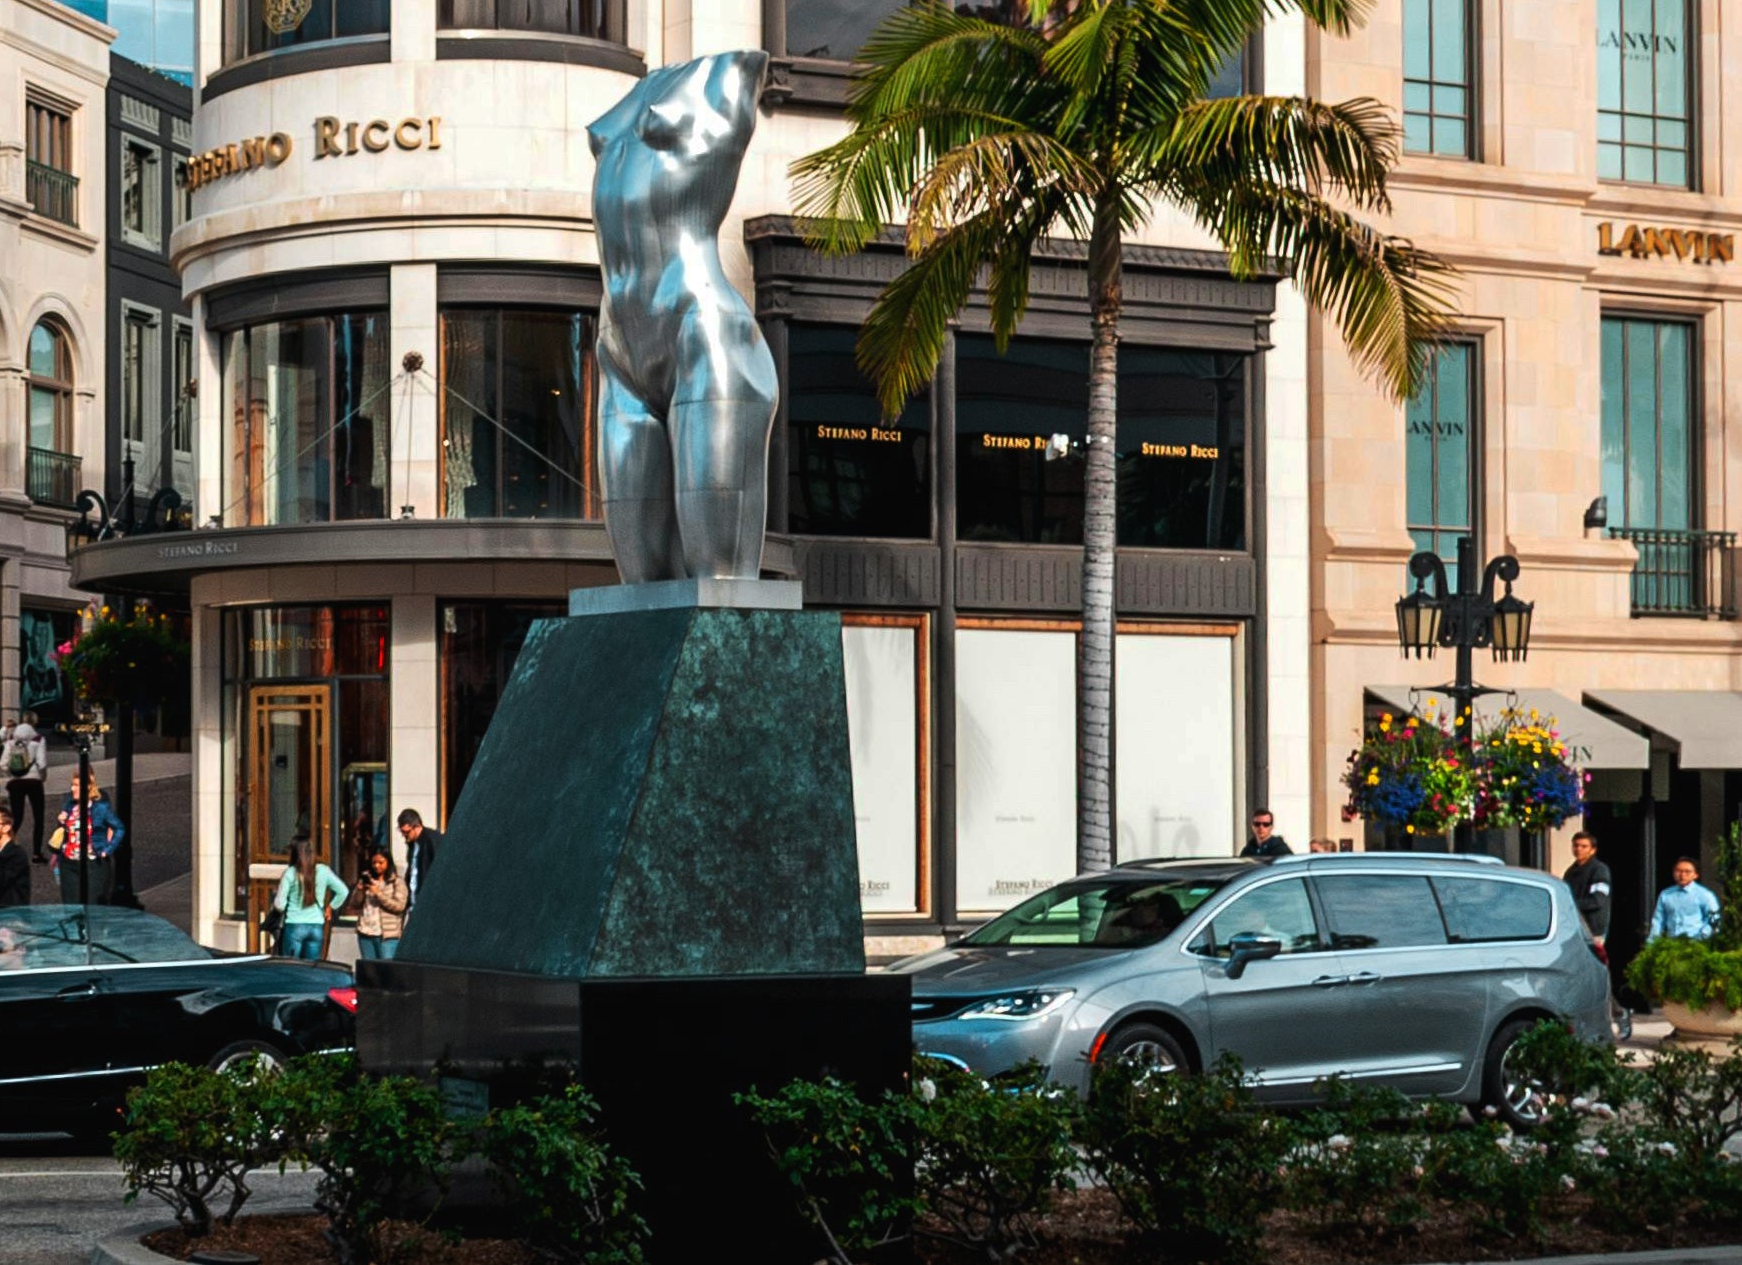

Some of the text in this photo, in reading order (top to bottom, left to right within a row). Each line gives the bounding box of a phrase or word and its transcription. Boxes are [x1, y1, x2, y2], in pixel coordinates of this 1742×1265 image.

[1597, 222, 1734, 266] LANVIN
[818, 424, 902, 443] STEFANO RICCI
[1407, 420, 1464, 436] ANVIN
[983, 433, 1031, 449] STEFANO
[1141, 441, 1219, 459] STEFANO RICCI
